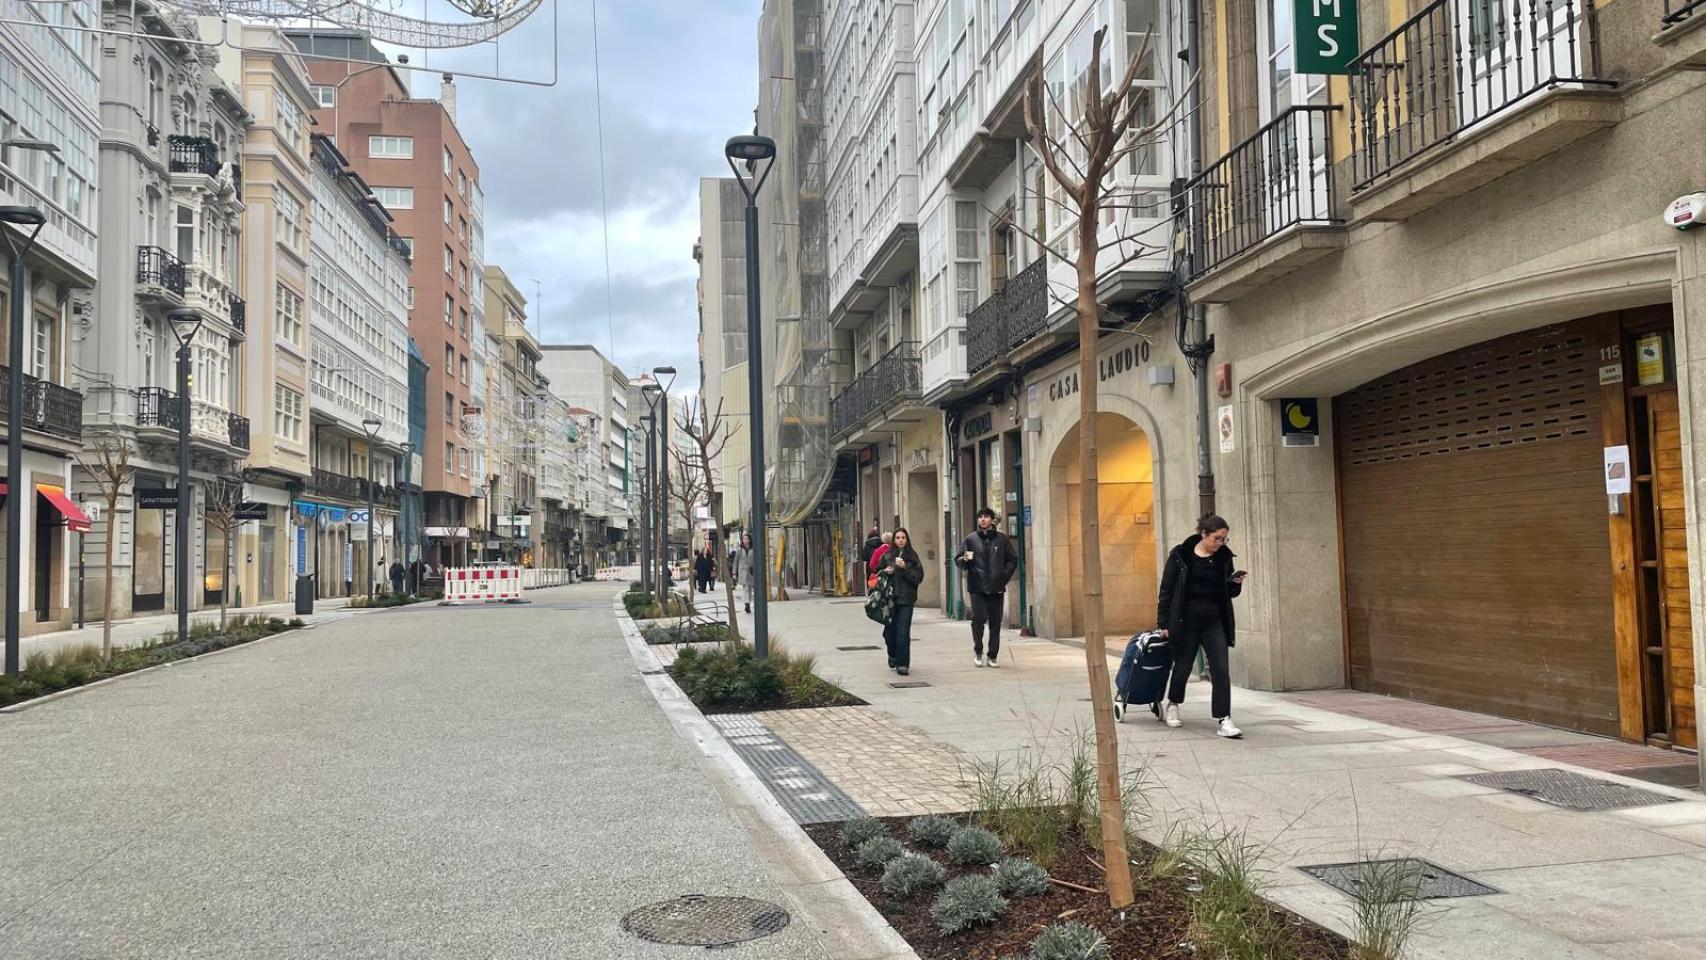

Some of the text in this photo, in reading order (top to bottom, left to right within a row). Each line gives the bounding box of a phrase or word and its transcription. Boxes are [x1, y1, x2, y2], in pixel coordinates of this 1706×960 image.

[1049, 339, 1150, 402] CASA LAUDIO
[1600, 344, 1620, 360] 115
